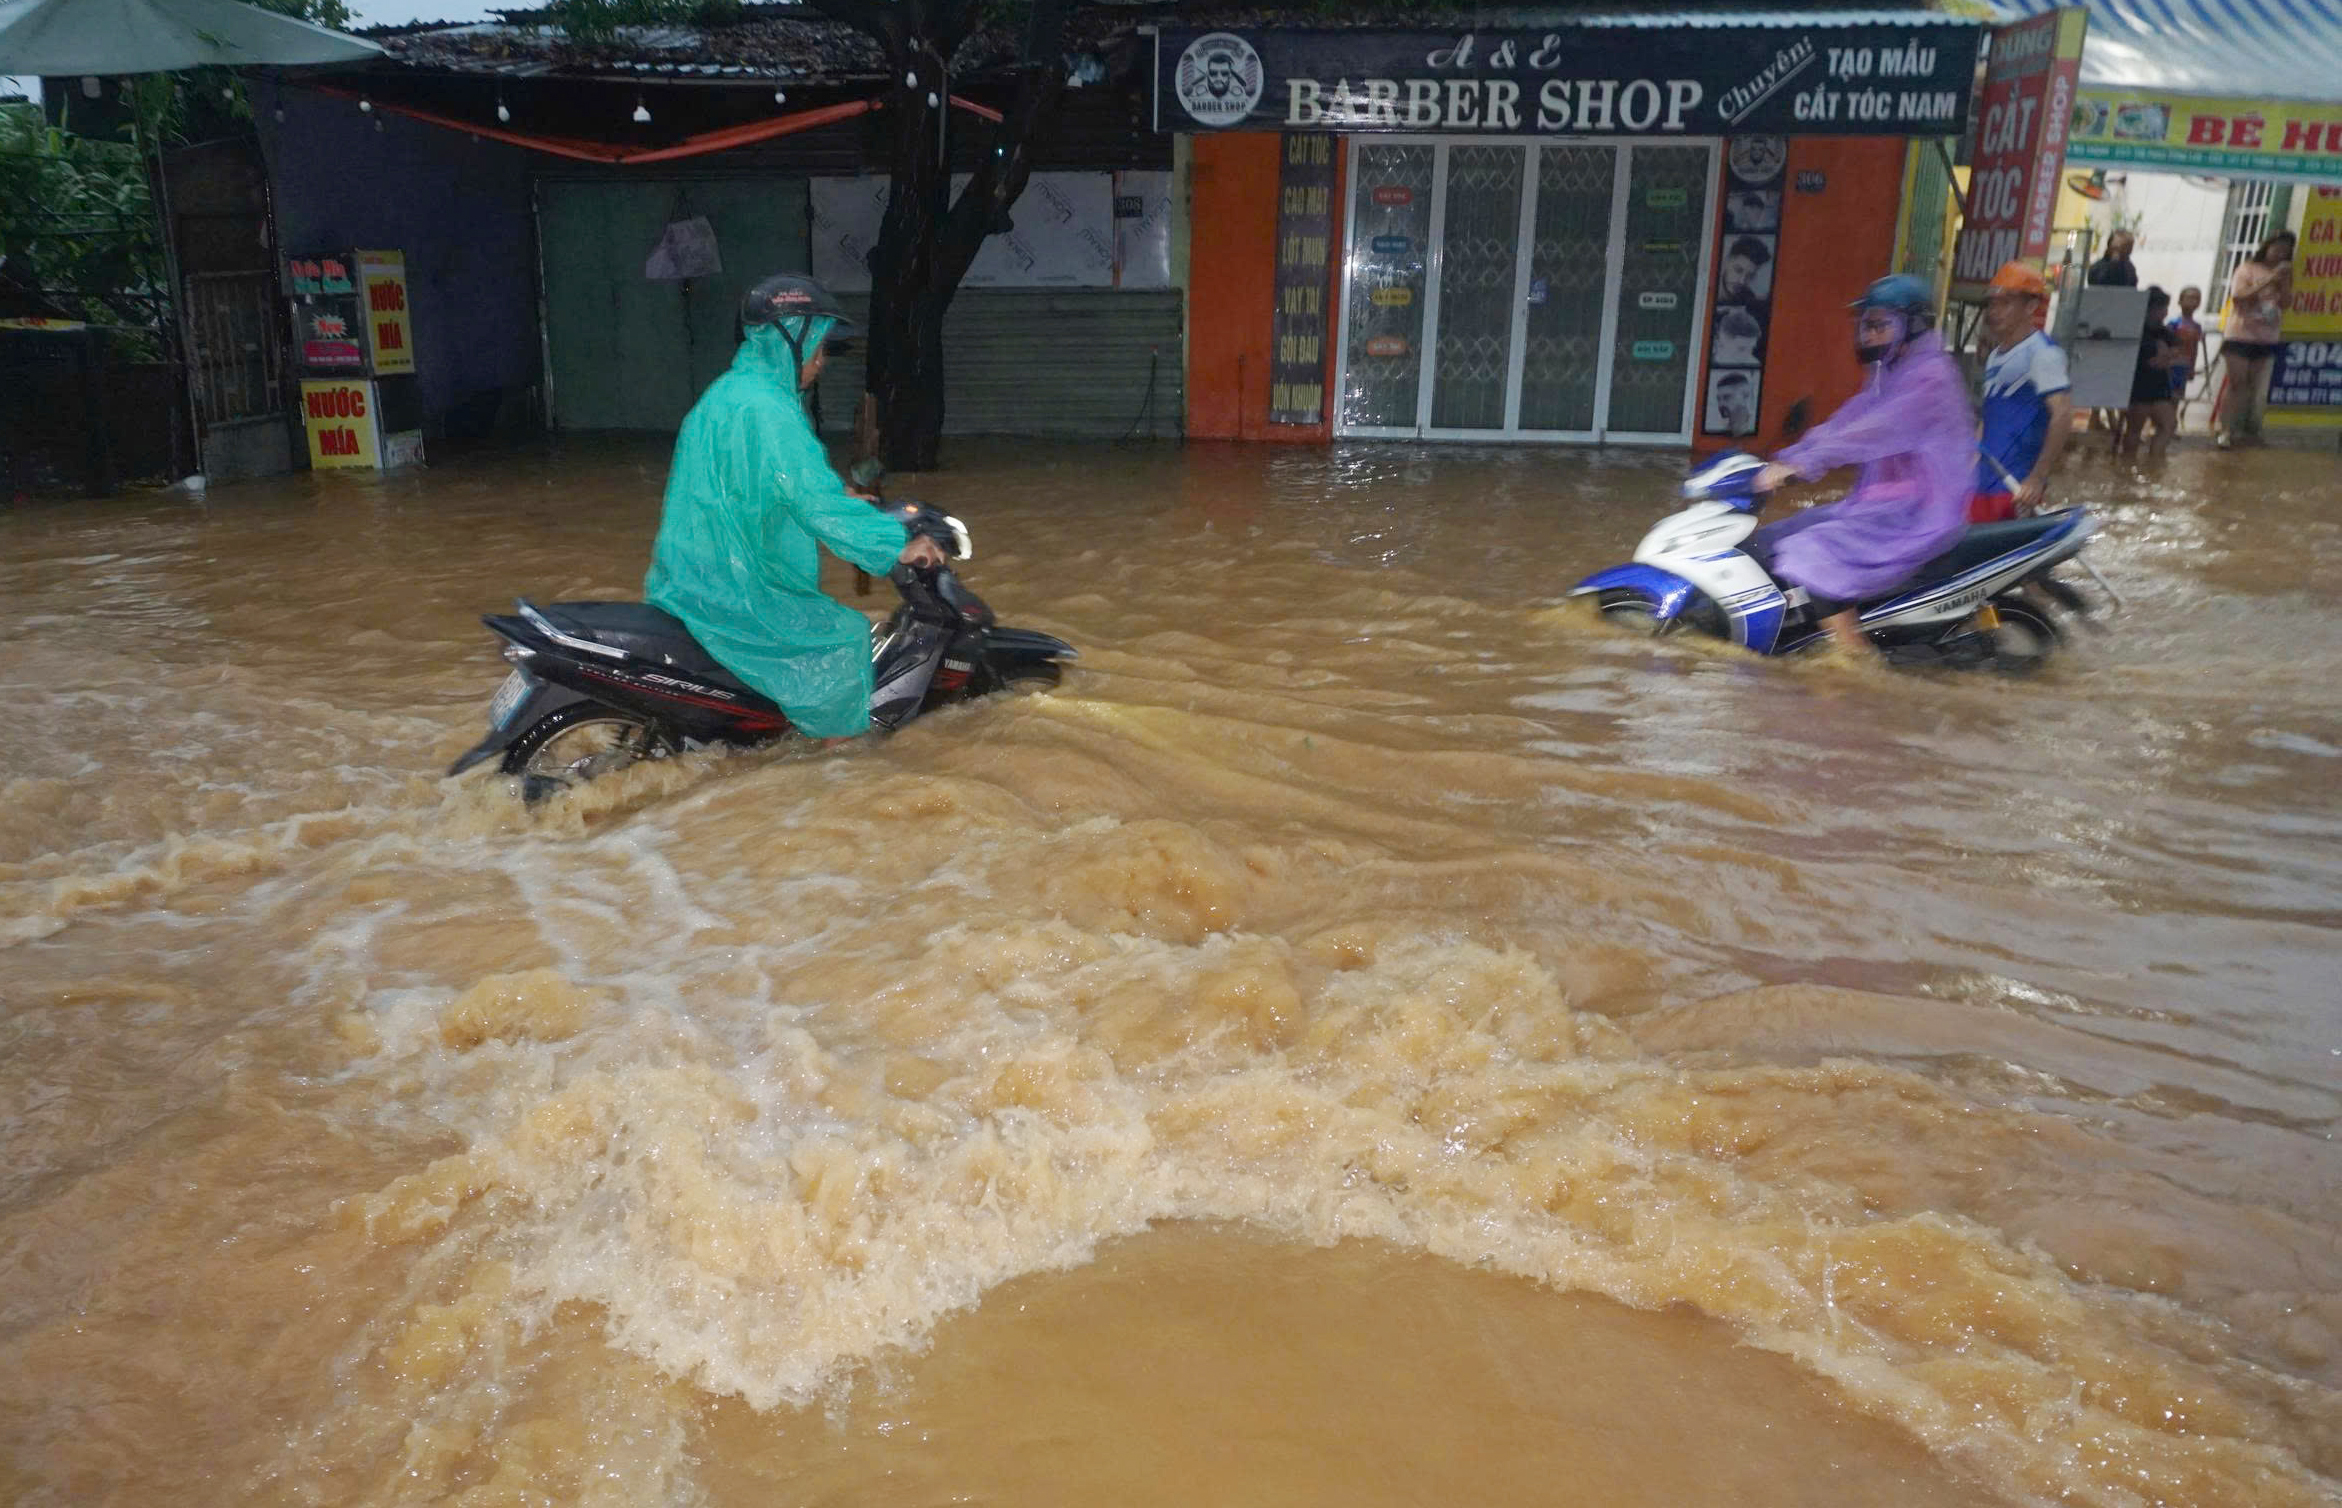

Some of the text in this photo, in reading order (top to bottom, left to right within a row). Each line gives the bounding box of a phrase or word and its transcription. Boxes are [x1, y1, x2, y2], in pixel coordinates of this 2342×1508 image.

[1426, 33, 1562, 70] A & E
[1827, 37, 1937, 83] TẠO MẪU
[1191, 101, 1246, 112] BARBER SHOP
[1283, 77, 1703, 131] BARBER SHOP
[1793, 82, 1957, 120] CẮT TÓC NAM
[1983, 78, 2037, 157] CẮT
[2029, 75, 2069, 245] BARBER SHOP
[1973, 156, 2023, 222] TÓC
[378, 318, 403, 350] MÍA
[305, 386, 366, 419] NƯỚC
[317, 425, 360, 456] MÍA
[1934, 587, 1987, 614] YAMAHA
[641, 673, 737, 700] SIRIUS
